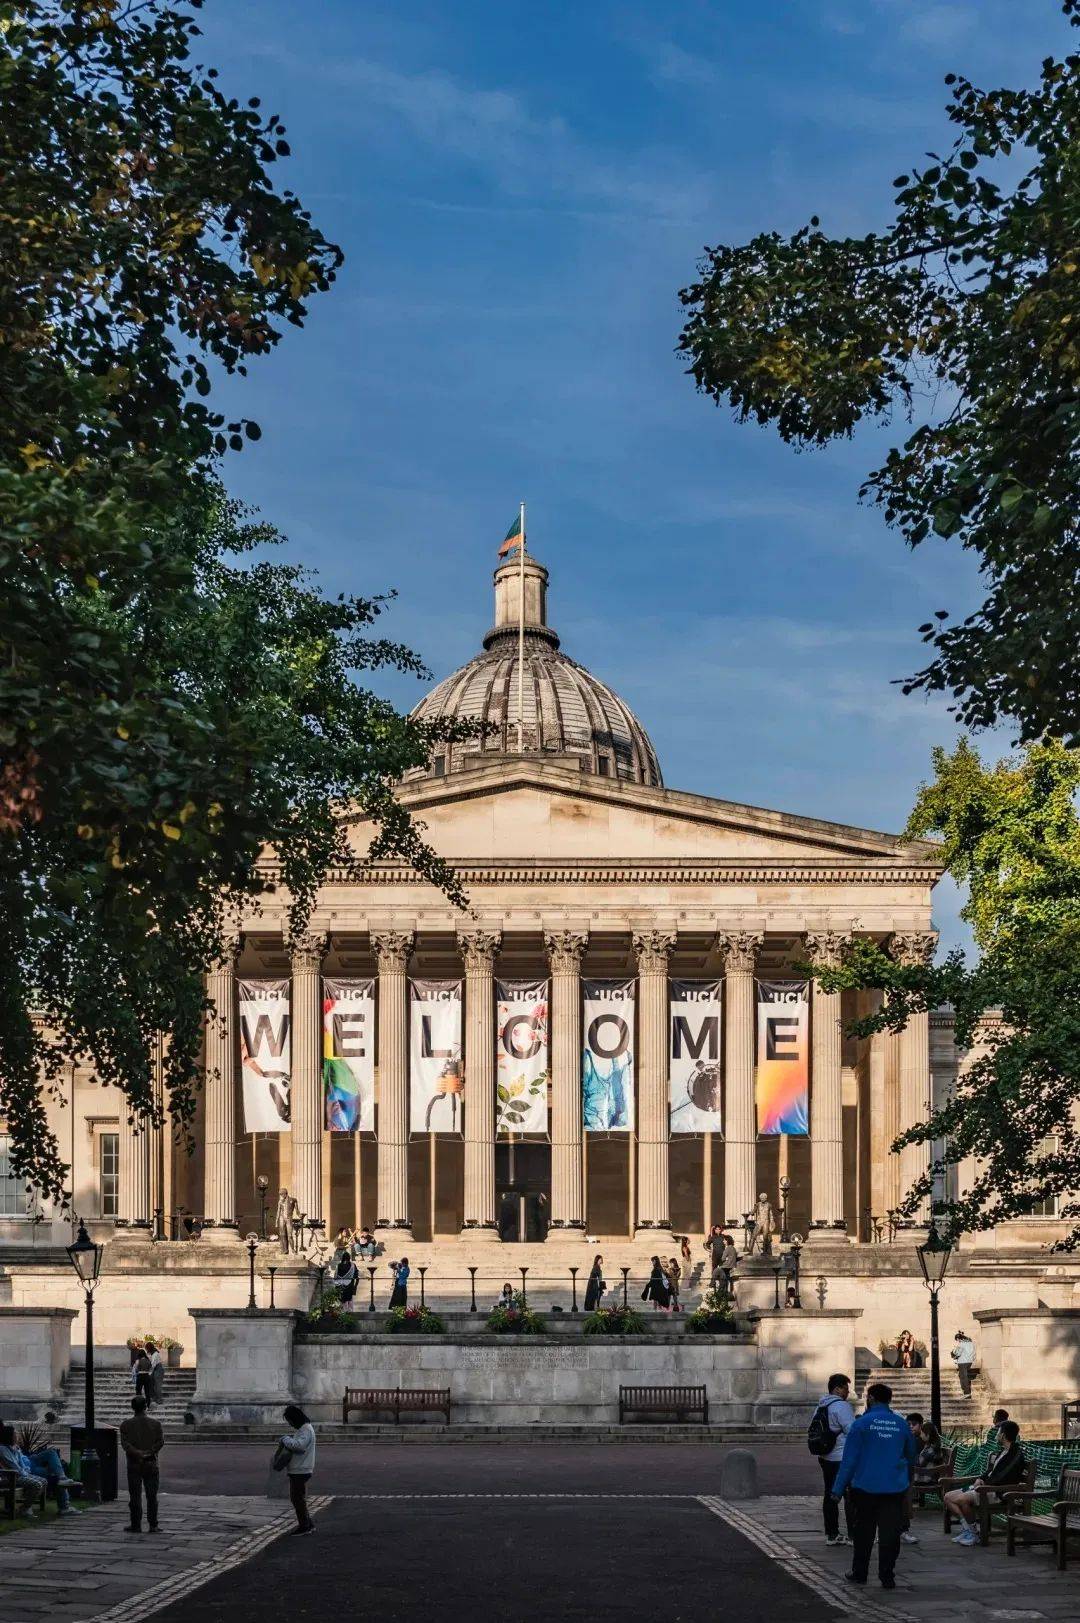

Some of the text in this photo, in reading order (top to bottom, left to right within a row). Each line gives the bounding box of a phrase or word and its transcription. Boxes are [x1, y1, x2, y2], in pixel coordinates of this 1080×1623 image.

[254, 990, 287, 1001] UCL
[340, 989, 372, 1001] UCL
[427, 990, 457, 1001] UCL
[513, 990, 545, 1001] UCL
[600, 989, 633, 1001] UCL
[686, 990, 719, 1002] UCL
[774, 992, 806, 1004] UCL
